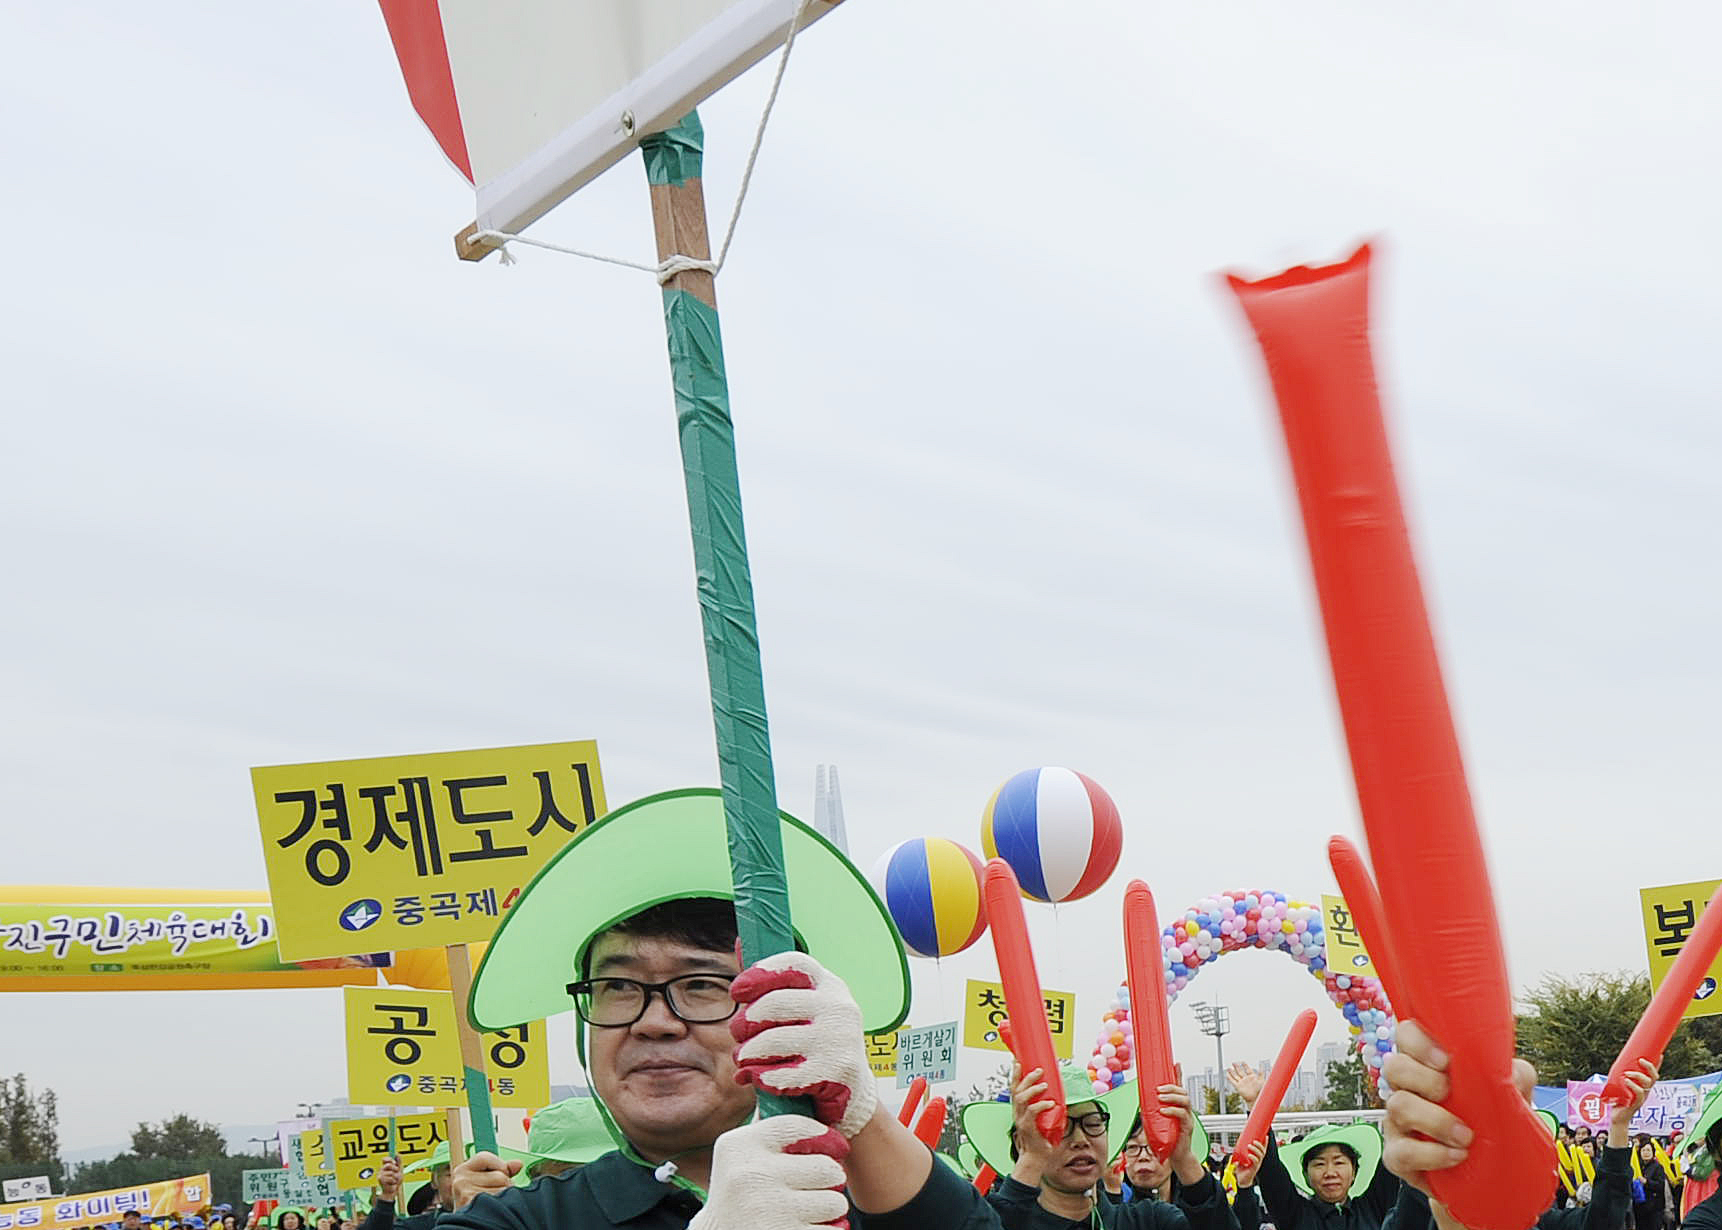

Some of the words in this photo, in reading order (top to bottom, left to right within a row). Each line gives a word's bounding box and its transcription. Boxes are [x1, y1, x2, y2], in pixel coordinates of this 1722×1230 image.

[274, 762, 596, 887] 경제도시
[0, 911, 271, 956] 진구민체육대회
[900, 1027, 955, 1052] 바르게살기
[338, 1119, 448, 1161] 교육도시
[57, 1189, 151, 1221] 화이팅!
